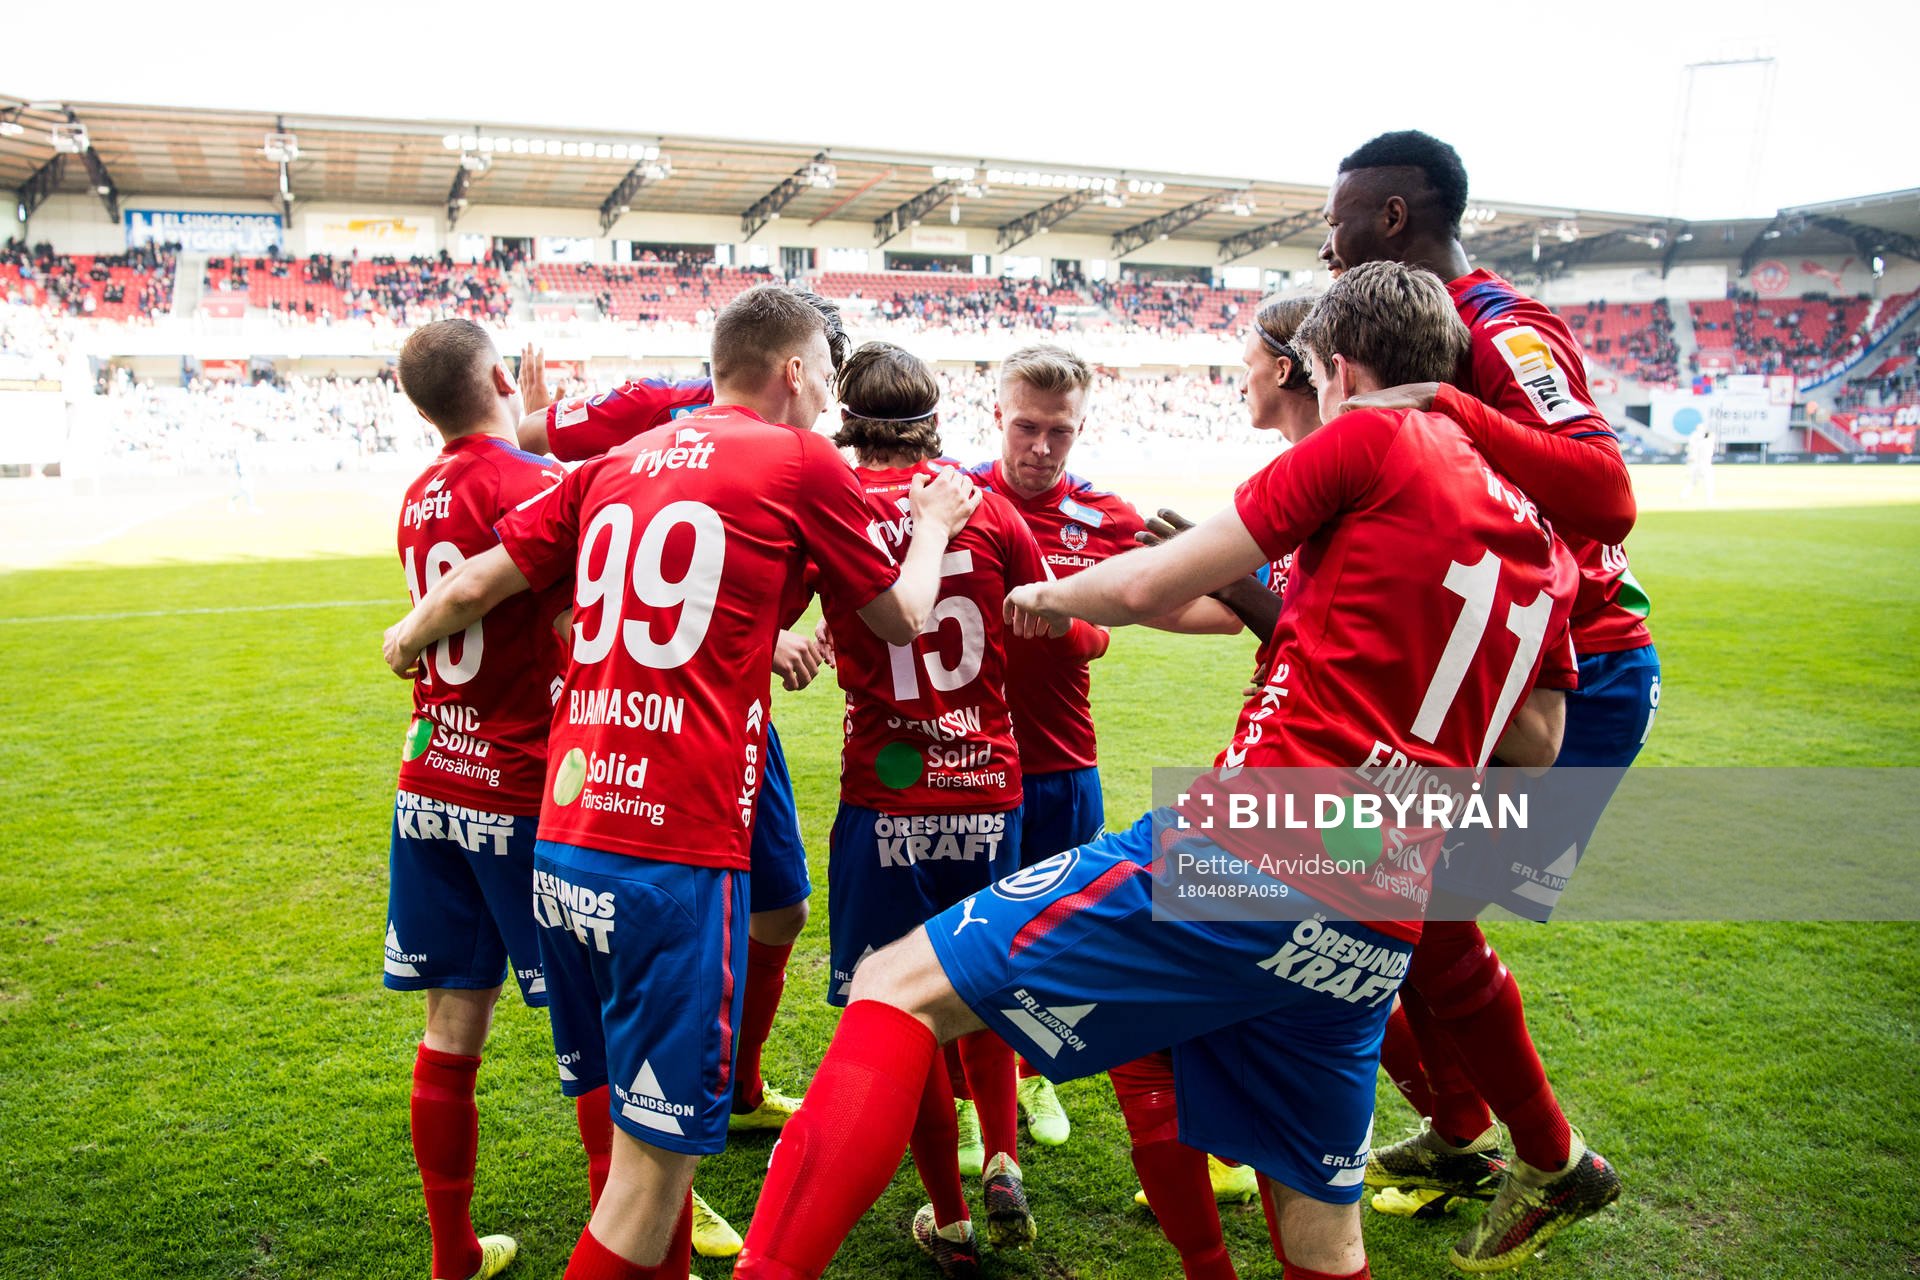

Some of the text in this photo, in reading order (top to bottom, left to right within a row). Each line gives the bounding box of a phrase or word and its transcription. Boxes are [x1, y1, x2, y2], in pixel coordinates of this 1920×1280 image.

[630, 442, 715, 477] inyett
[404, 490, 452, 530] inyett
[1047, 553, 1096, 567] stadium
[572, 500, 726, 670] 99
[1410, 550, 1553, 776] 11
[422, 703, 481, 733] NIC
[1243, 664, 1290, 745] akea
[424, 750, 501, 787] Försäkring
[587, 751, 649, 789] Solid
[928, 743, 992, 768] Solid
[738, 743, 758, 828] akea
[928, 770, 1005, 789] Försäkring
[1355, 740, 1468, 832] ERIKSSO
[581, 788, 665, 826] Försäkring
[875, 812, 1005, 838] ÖRESUNDS
[397, 809, 514, 856] KRAFT
[877, 832, 1004, 868] KRAFT
[533, 868, 616, 919] RESUNDS
[1511, 861, 1569, 889] ERLAND
[1256, 941, 1404, 1008] KRAFT
[1013, 988, 1087, 1052] ERLANDSSON
[614, 1083, 695, 1117] ERLANDSSON
